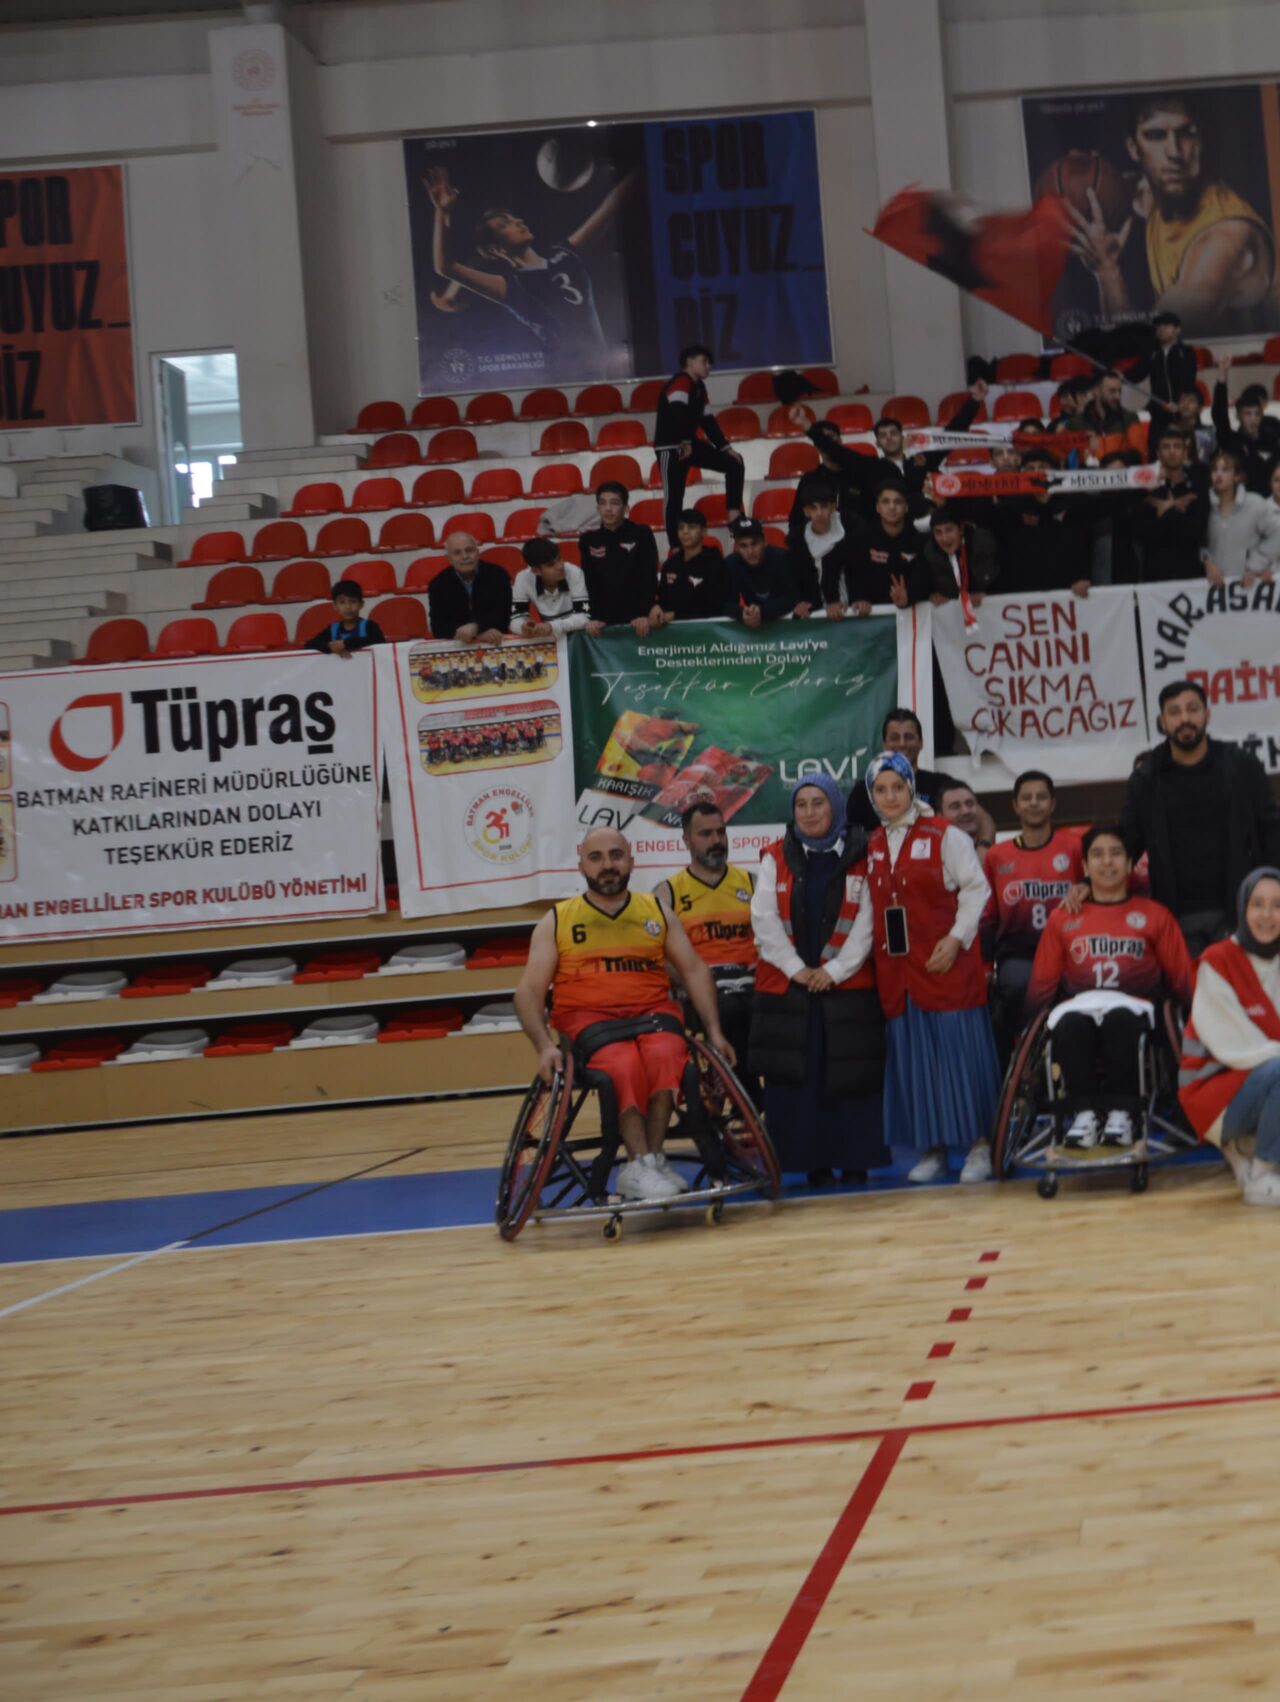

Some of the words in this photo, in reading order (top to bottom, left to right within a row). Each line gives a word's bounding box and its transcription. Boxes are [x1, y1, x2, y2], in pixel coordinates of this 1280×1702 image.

[662, 121, 769, 195] SPOR
[552, 273, 584, 306] 3
[1002, 600, 1078, 639] SEN
[638, 645, 706, 661] Enerjimizi
[710, 642, 776, 656] Aldığımız
[655, 653, 762, 668] Desteklerinden
[766, 652, 812, 666] Dolayı
[984, 672, 1098, 707] SIKMA
[130, 687, 336, 762] Tüpraş
[17, 786, 104, 808] BATMAN
[111, 777, 207, 802] RAFİNERİ
[213, 764, 373, 793] MÜDÜRLÜĞÜNE
[597, 778, 655, 797] KARIŞIK
[73, 807, 241, 836] KATKILARINDAN
[249, 800, 322, 823] DOLAYI
[104, 838, 214, 865] TEŞEKKÜR
[220, 832, 294, 857] EDERİZ
[732, 835, 771, 850] SPOR
[34, 892, 145, 917] ENGELLİLER
[150, 890, 197, 908] SPOR
[203, 879, 276, 903] KULÜBÜ
[281, 873, 367, 897] YÖNETİMİ
[680, 895, 693, 912] 5
[1032, 904, 1048, 930] 8
[571, 924, 587, 944] 6
[1092, 961, 1120, 989] 12
